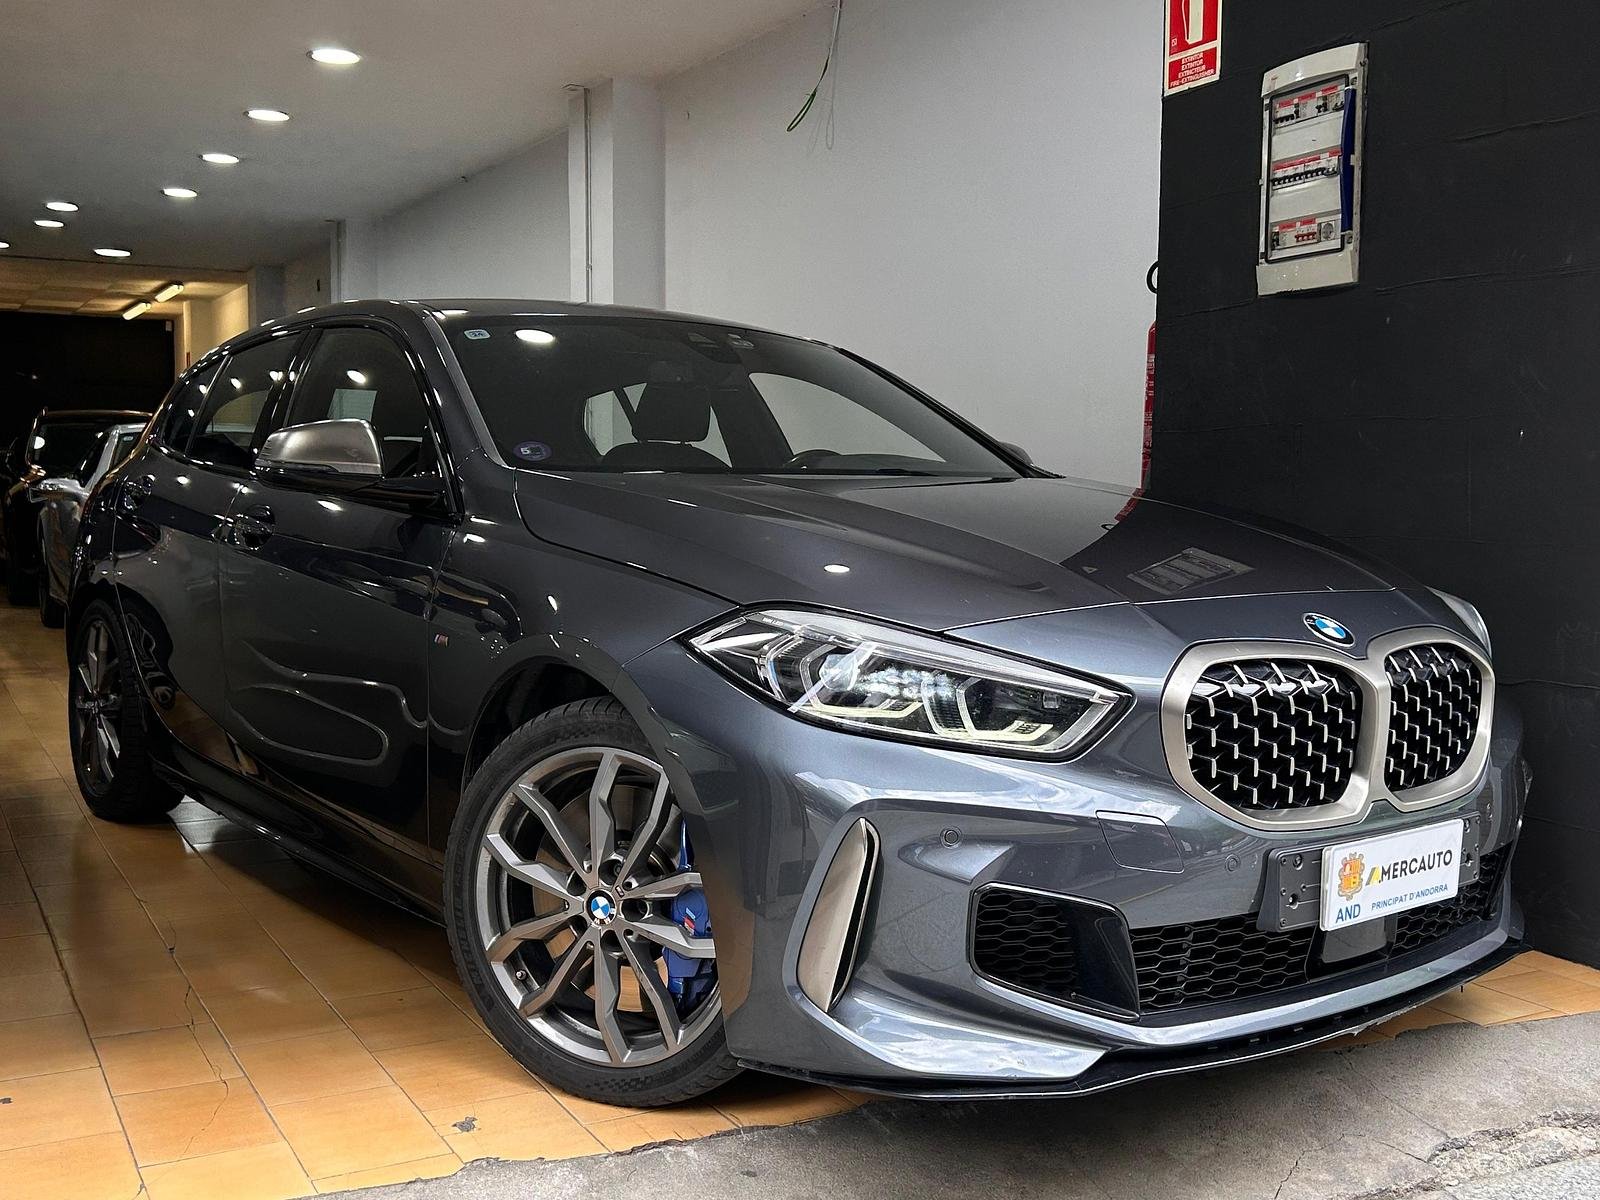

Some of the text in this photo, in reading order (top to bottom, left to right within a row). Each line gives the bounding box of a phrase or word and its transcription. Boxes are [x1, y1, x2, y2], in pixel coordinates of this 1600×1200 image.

[1371, 884, 1448, 911] PRINCIPAT D'ANDORRA
[1335, 904, 1361, 923] AND
